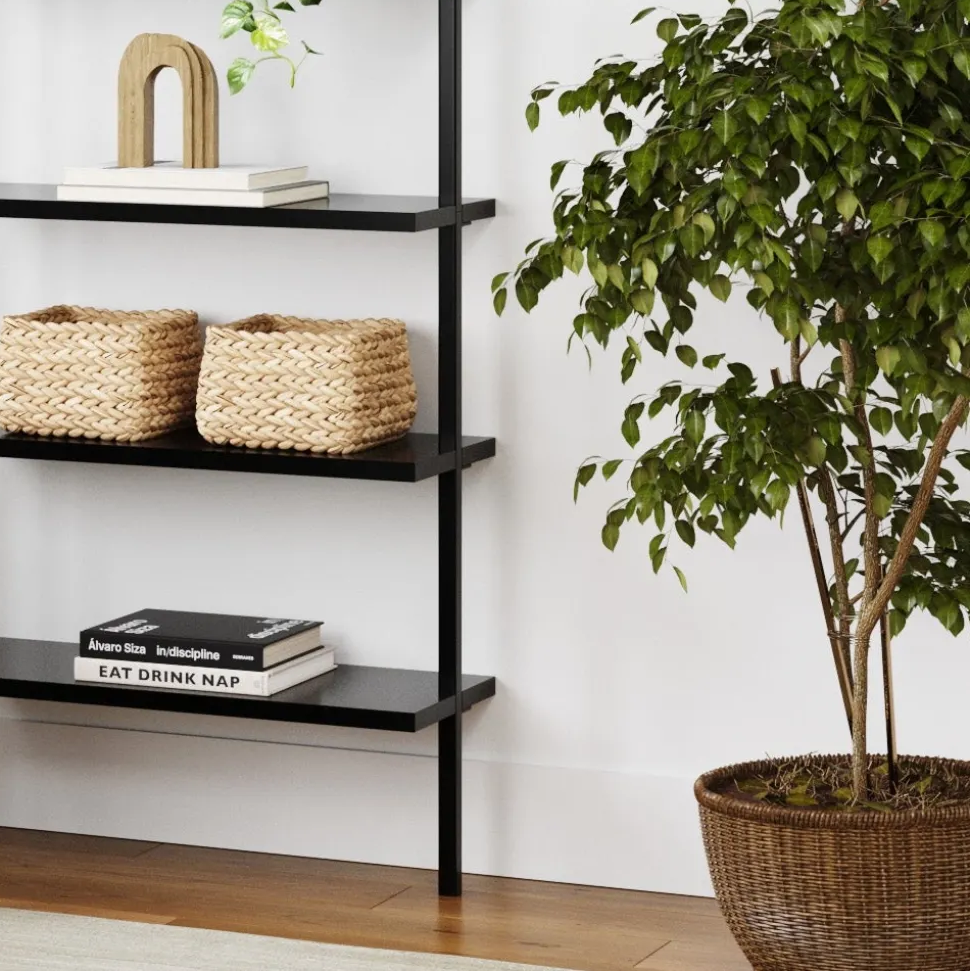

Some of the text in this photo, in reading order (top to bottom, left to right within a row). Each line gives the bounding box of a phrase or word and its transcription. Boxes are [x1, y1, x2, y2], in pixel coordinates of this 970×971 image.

[88, 637, 122, 652] Álvaro
[124, 643, 146, 655] Siza
[156, 645, 220, 661] in/discipline
[99, 665, 240, 688] EAT DRINK NAP
